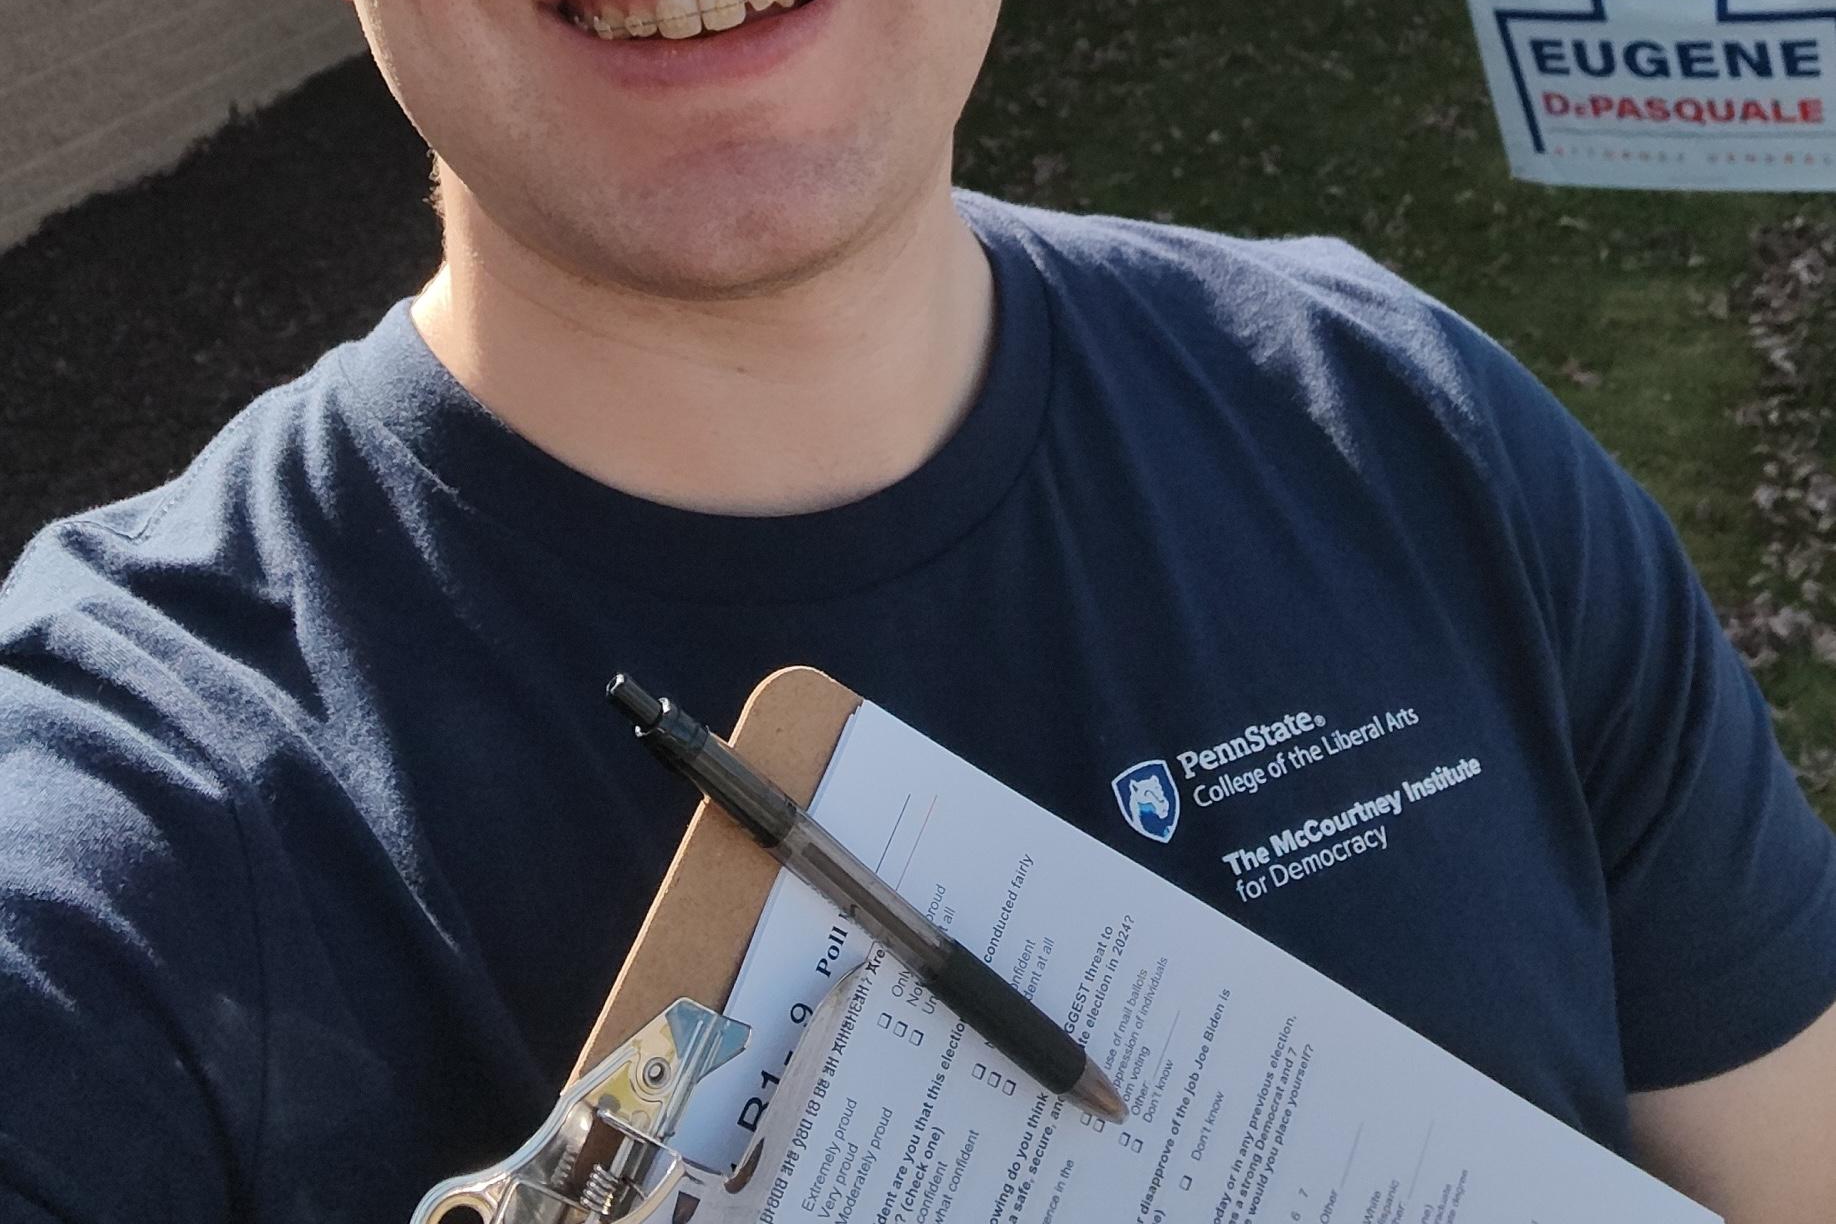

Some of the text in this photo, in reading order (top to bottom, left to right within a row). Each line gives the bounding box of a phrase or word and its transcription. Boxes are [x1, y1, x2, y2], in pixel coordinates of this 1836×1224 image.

[1529, 38, 1822, 79] EUGENE
[1193, 707, 1420, 807] College of the Liberal Arts
[1222, 757, 1482, 877] The McCourtney Institute
[1235, 825, 1389, 903] for Democracy
[815, 926, 849, 979] Poll
[1037, 955, 1050, 972] at
[1042, 936, 1055, 956] all
[1139, 956, 1168, 1017] individuals
[1218, 988, 1231, 1002] is
[892, 1164, 909, 1191] are
[903, 1133, 921, 1165] you
[914, 1101, 934, 1133] that
[926, 1072, 946, 1102] this
[940, 1019, 966, 1071] electio
[983, 889, 1018, 964] conducted
[1011, 853, 1035, 890] fairly
[1104, 968, 1148, 1071] use of mail ballots
[1134, 1015, 1145, 1029] of
[1203, 1003, 1225, 1043] Biden
[817, 1185, 843, 1220] Very
[836, 1142, 859, 1186] proud
[942, 906, 957, 926] all
[1007, 1160, 1021, 1181] do
[1016, 1131, 1033, 1161] you
[1027, 1091, 1049, 1129] think
[1084, 940, 1108, 983] threat
[1100, 925, 1114, 941] to
[1014, 1177, 1035, 1213] safe,
[1028, 1123, 1057, 1176] secure,
[1086, 972, 1113, 1029] election
[1105, 958, 1119, 973] in
[1112, 914, 1135, 957] 2024?
[1131, 1045, 1151, 1081] voting
[1194, 1043, 1210, 1071] Joe
[1281, 1057, 1294, 1086] and
[1287, 1046, 1299, 1057] 7
[1142, 1058, 1174, 1124] Don't know
[1176, 1095, 1191, 1120] the
[1183, 1071, 1200, 1097] job
[1248, 1071, 1274, 1131] previous
[870, 1106, 894, 1151] proud
[1170, 1118, 1182, 1136] of
[1190, 1090, 1225, 1162] Don't know
[1248, 1042, 1315, 1217] would you place yourself?
[1254, 1085, 1285, 1152] Democrat
[801, 1140, 842, 1213] Extremely
[834, 1097, 858, 1142] proud
[948, 1129, 980, 1194] confident
[1231, 1158, 1244, 1173] in
[1239, 1130, 1255, 1158] any
[900, 1161, 929, 1213] (check
[923, 1126, 946, 1160] one)
[917, 1160, 949, 1224] confident
[1054, 1180, 1067, 1193] in
[1060, 1159, 1075, 1179] the
[1139, 1138, 1175, 1216] disapprove
[1226, 1173, 1240, 1191] or
[1240, 1153, 1263, 1198] strong
